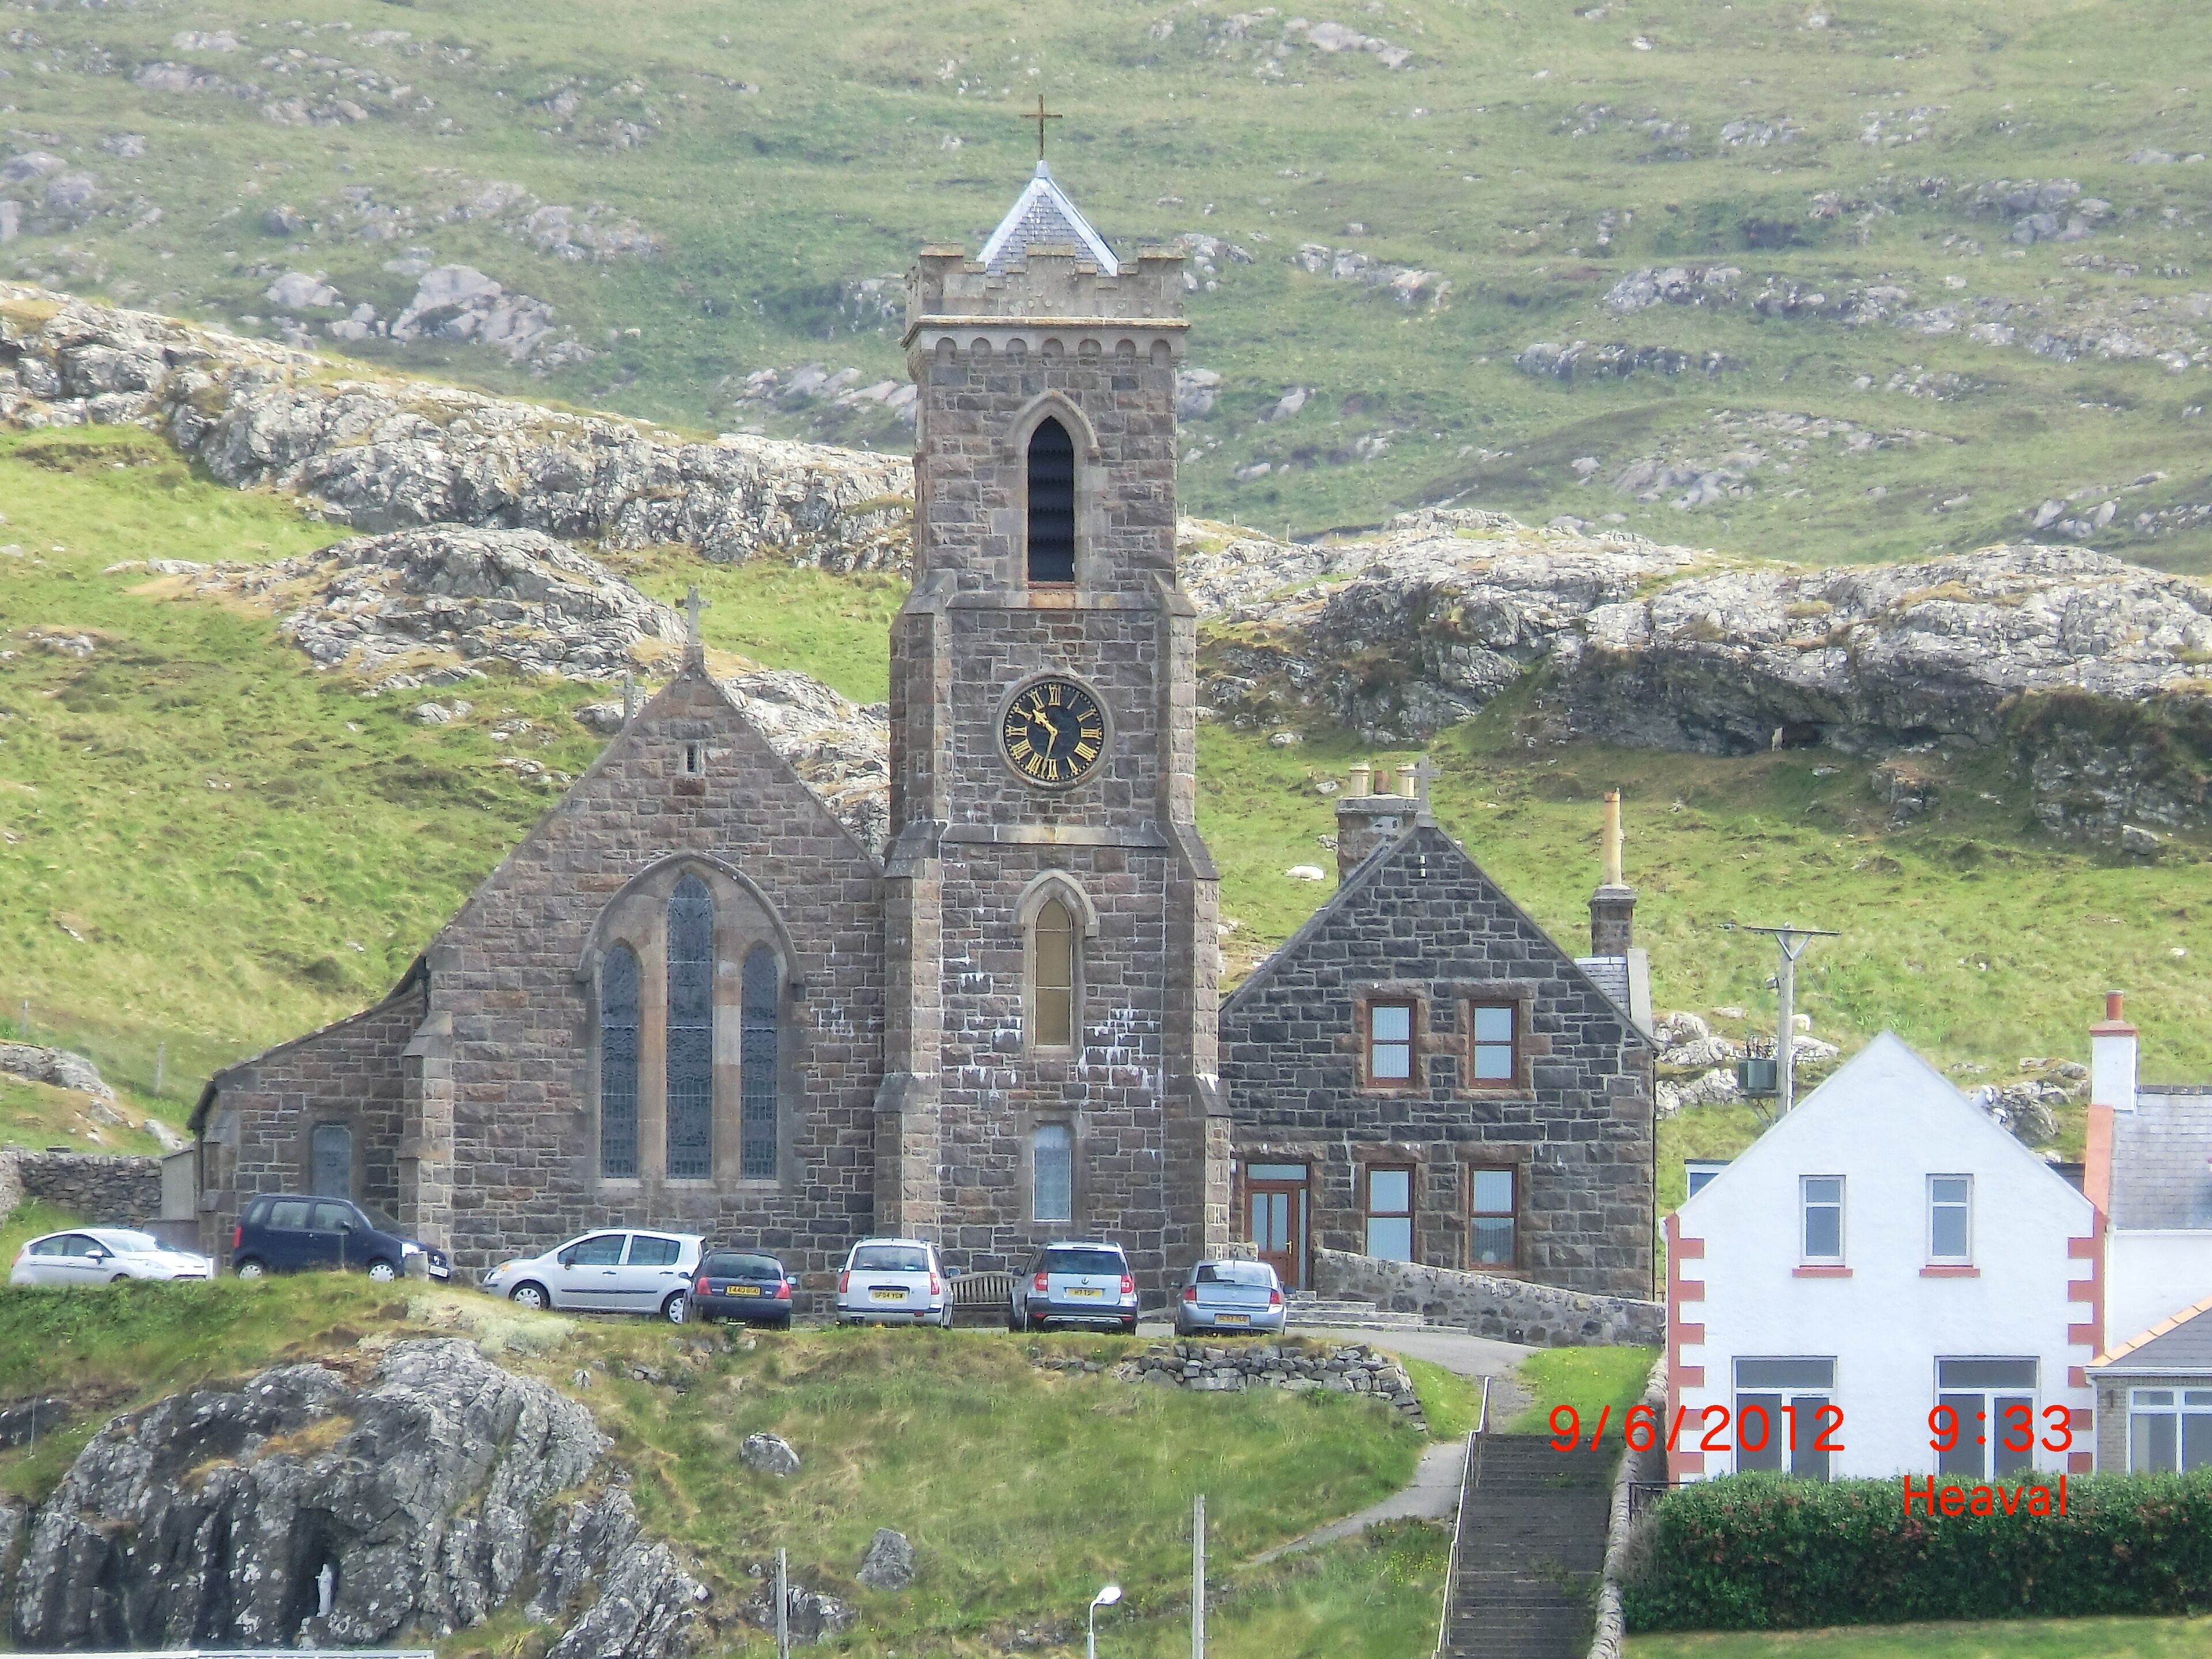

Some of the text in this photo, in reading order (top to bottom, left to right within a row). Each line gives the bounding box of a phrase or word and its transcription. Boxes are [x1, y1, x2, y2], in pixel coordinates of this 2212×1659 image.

[1048, 684, 1060, 706] XII
[1013, 702, 1033, 720] X
[1076, 707, 1096, 723] II
[1005, 725, 1027, 737] IX
[1066, 756, 1078, 775] V
